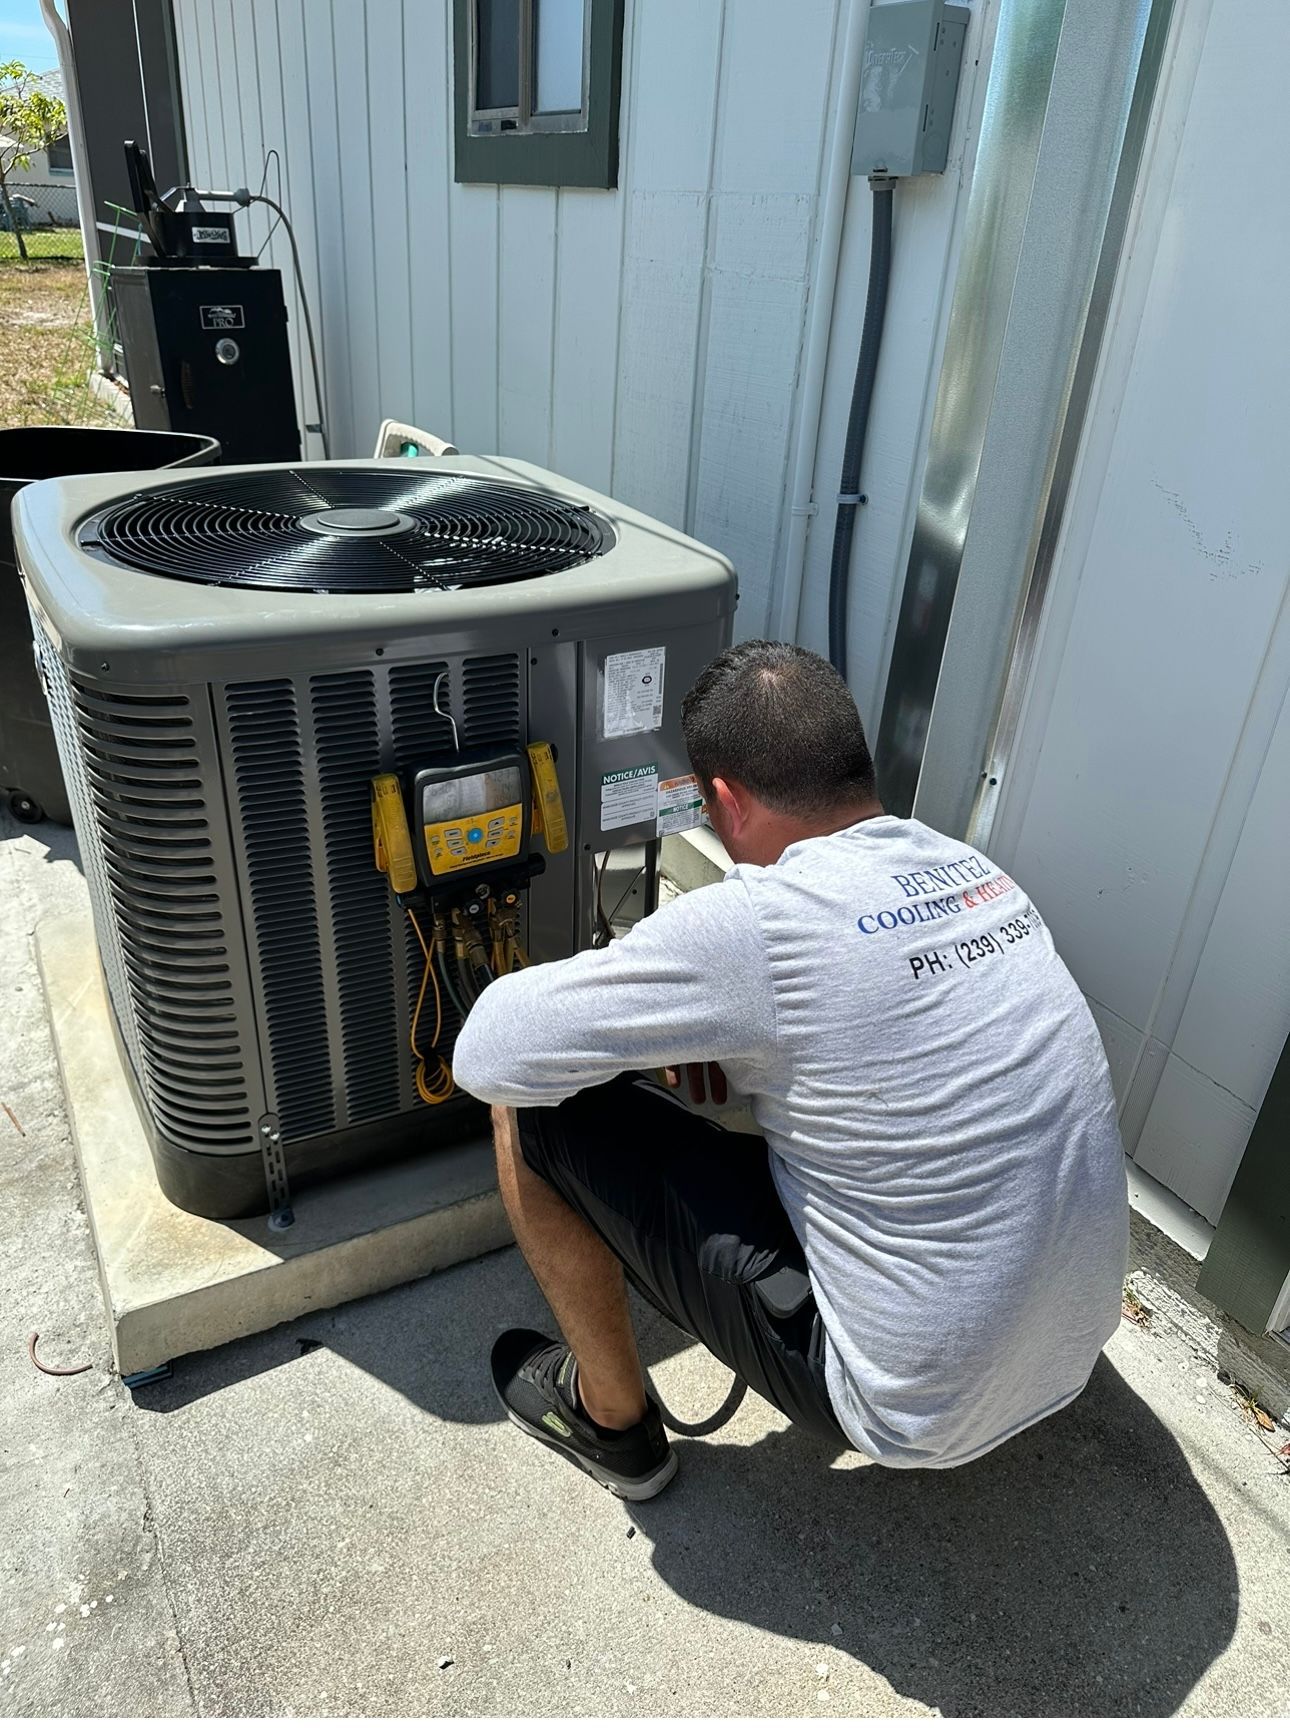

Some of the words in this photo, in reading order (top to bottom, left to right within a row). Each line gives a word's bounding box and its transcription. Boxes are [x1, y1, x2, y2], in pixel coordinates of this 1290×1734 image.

[213, 317, 234, 328] PRO
[603, 765, 656, 784] NOTICE/AVIS
[672, 803, 689, 812] NOTICE
[891, 855, 991, 898] BENITEZ
[857, 895, 961, 935] COOLING
[962, 890, 978, 910] &
[975, 875, 1016, 902] HEATIN
[909, 951, 953, 980] PH:
[954, 932, 1005, 969] (239)
